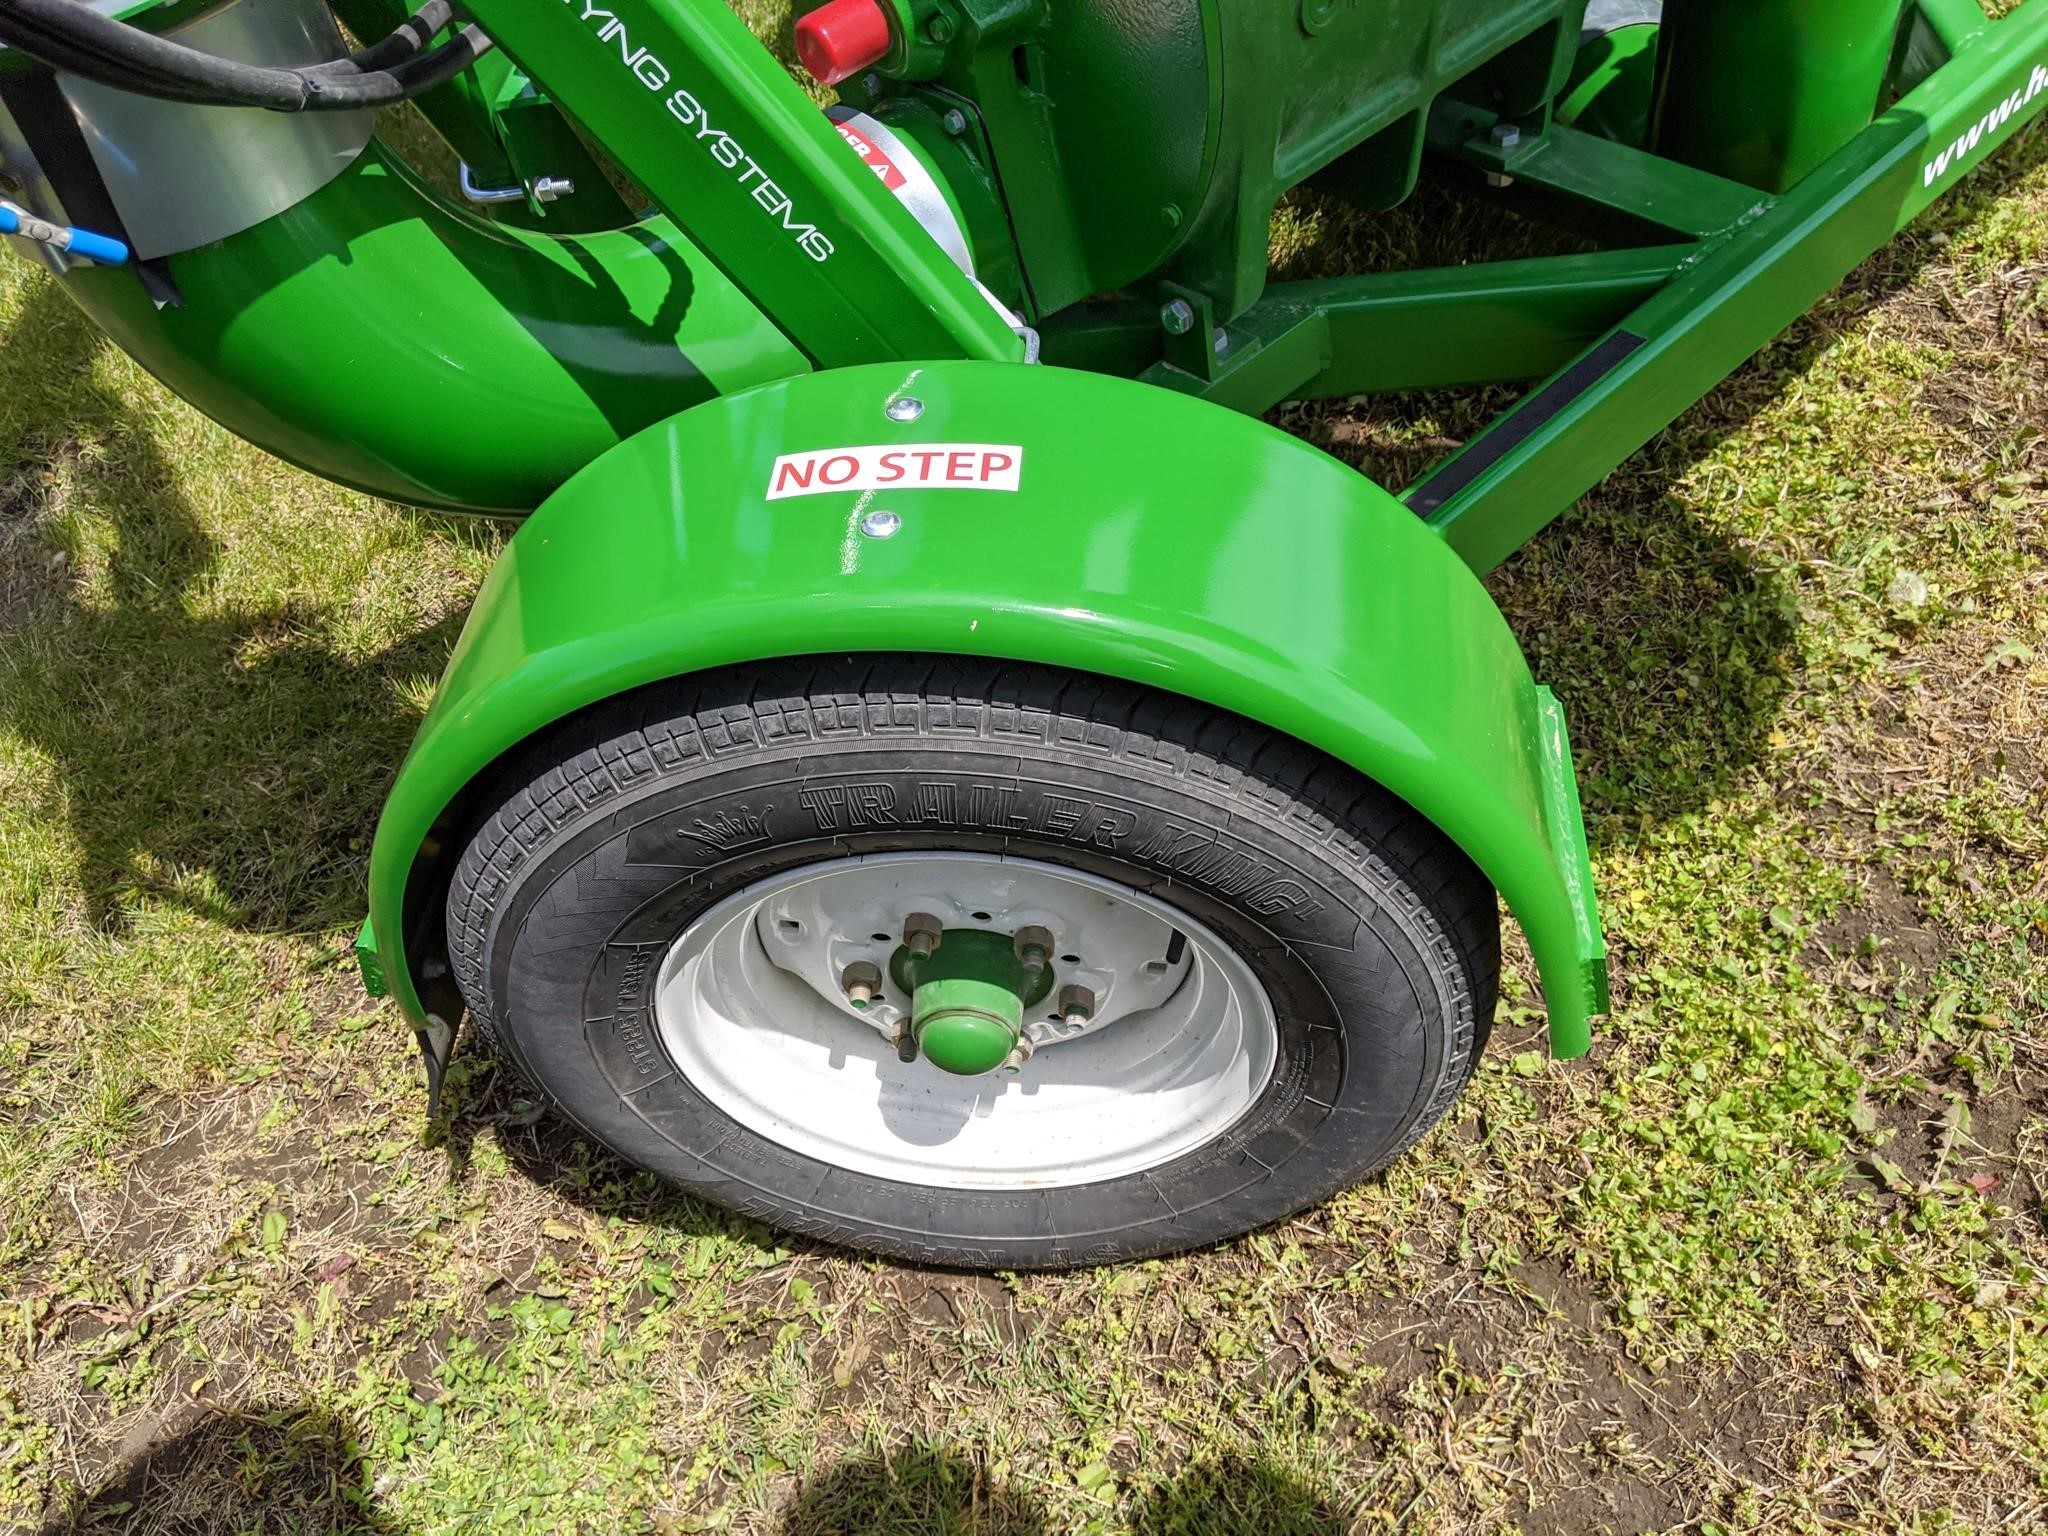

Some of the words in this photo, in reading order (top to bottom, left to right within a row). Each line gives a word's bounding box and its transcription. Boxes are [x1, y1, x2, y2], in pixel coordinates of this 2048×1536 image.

[564, 0, 671, 91] YING
[666, 88, 835, 263] SYSTEMS
[1923, 63, 2048, 188] www.h
[775, 455, 860, 492] NO
[876, 452, 1013, 482] STEP
[798, 782, 1138, 849] TRAILER
[1131, 822, 1312, 915] KING
